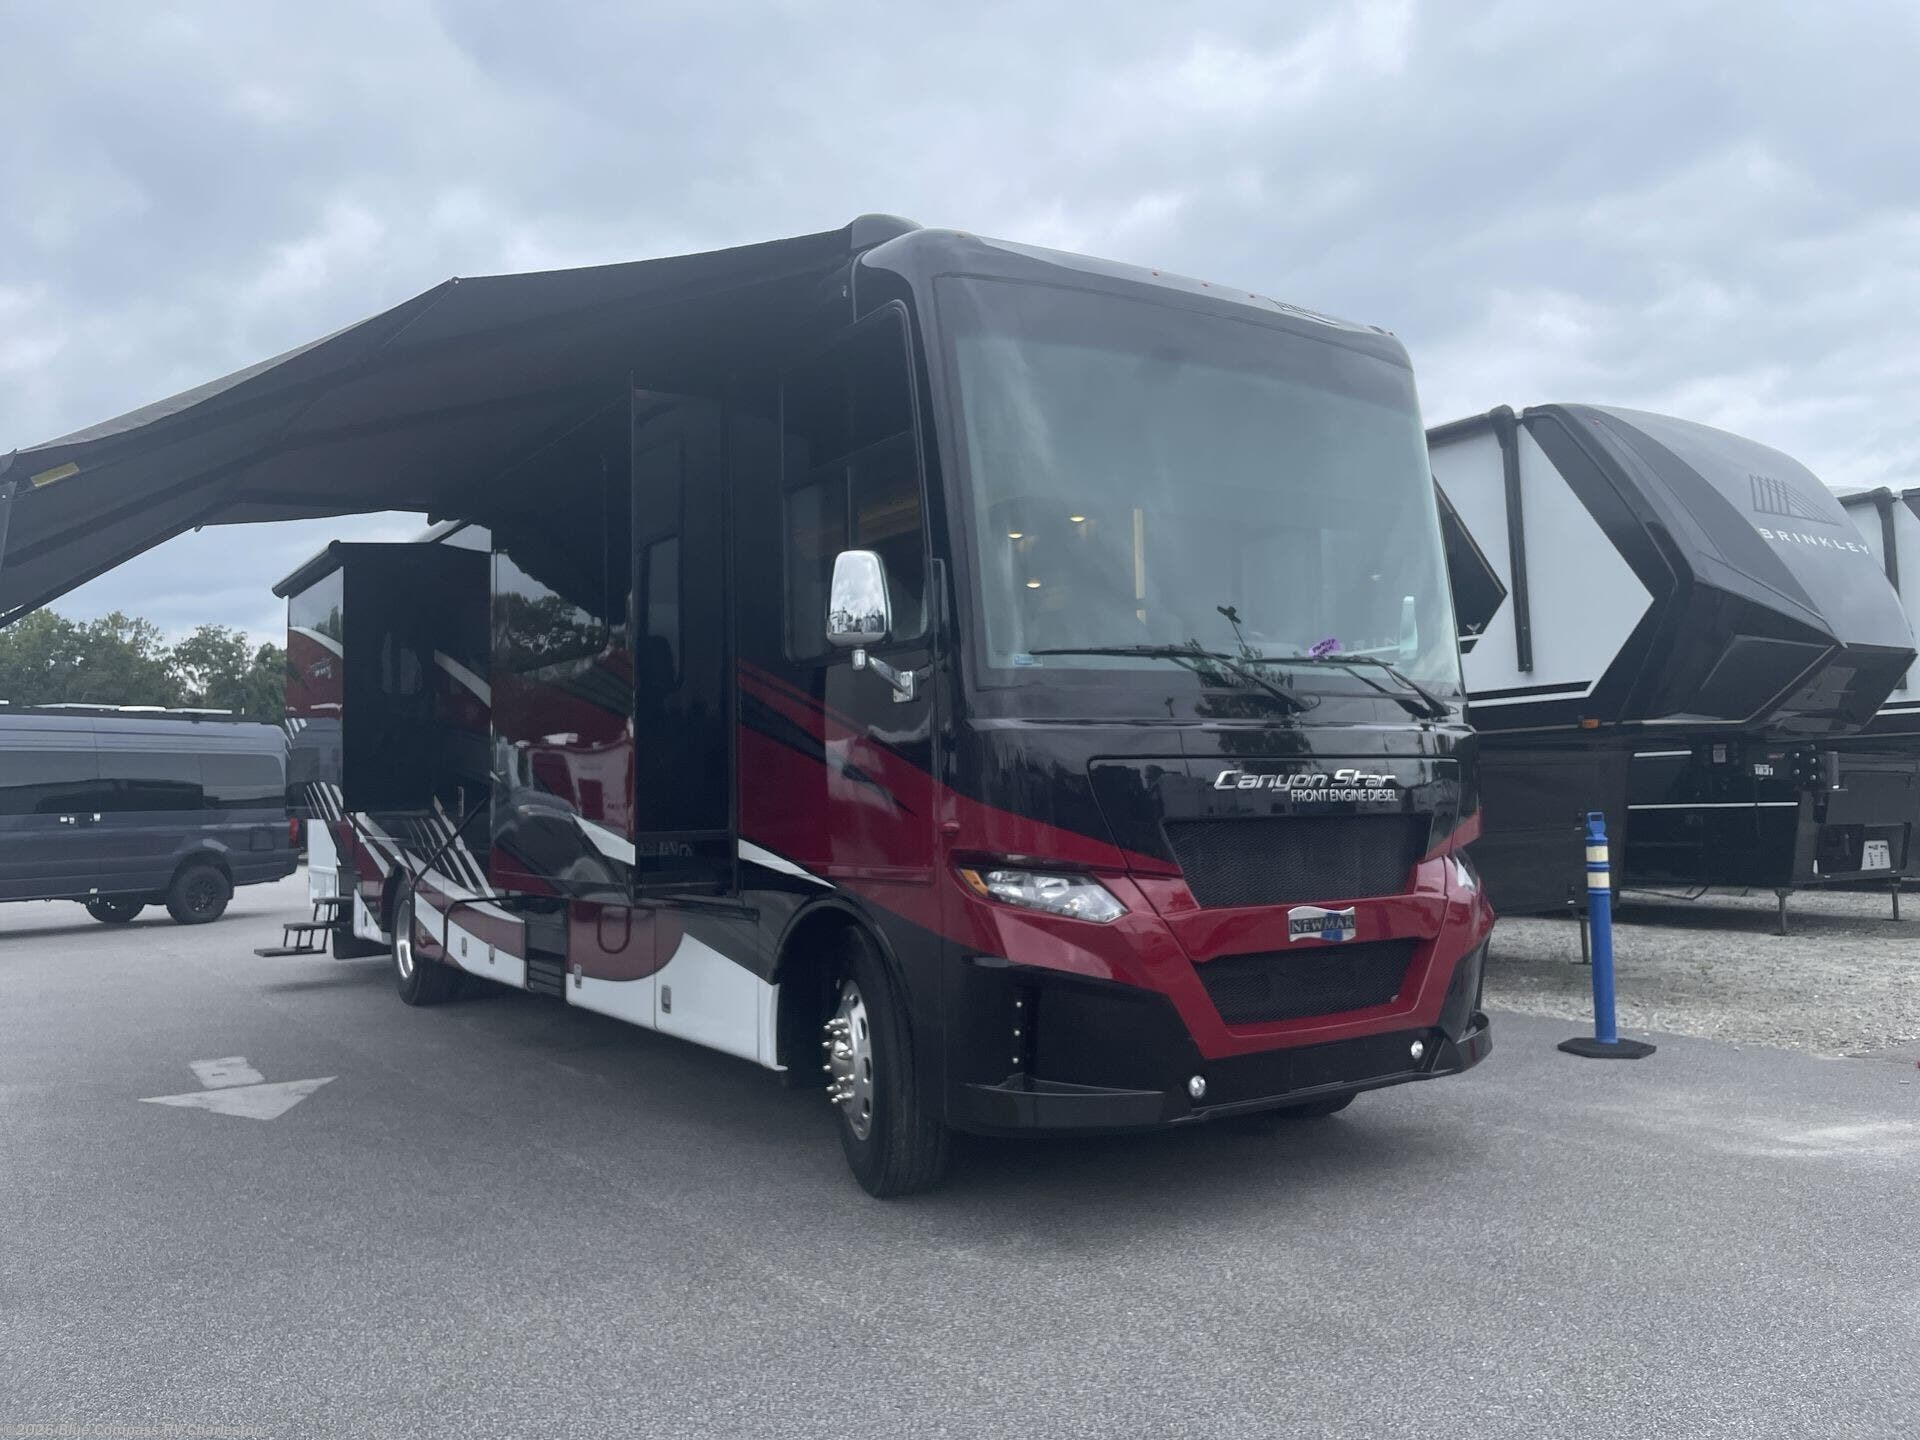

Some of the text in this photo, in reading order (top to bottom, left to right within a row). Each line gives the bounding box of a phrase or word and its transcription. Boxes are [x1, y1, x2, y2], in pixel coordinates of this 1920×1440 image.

[1759, 528, 1870, 555] BRINKLEY
[1213, 768, 1396, 793] Canyon Star
[1290, 788, 1399, 803] FRONT ENGINE DIESEL
[1291, 914, 1355, 934] NEWMAR
